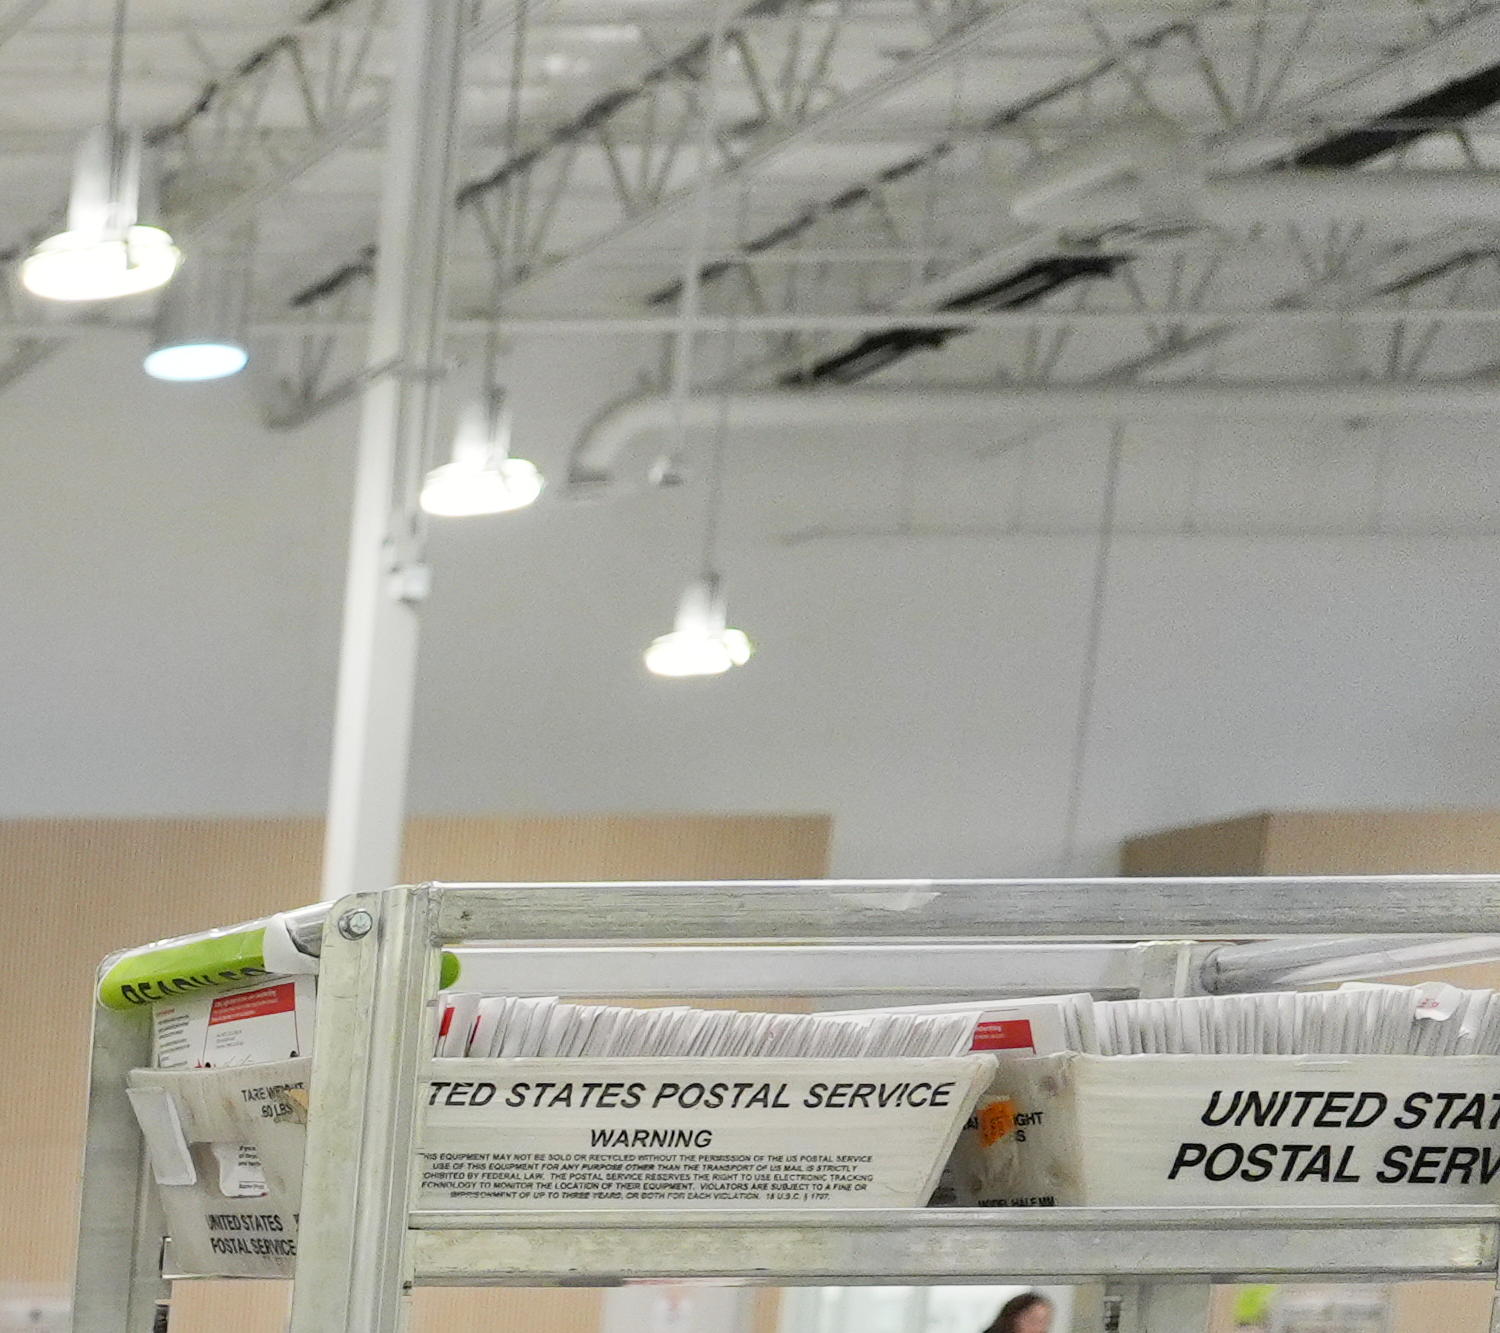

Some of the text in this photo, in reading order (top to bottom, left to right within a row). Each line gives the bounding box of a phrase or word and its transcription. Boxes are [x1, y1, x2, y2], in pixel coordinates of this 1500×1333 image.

[505, 1081, 956, 1109] STATES POSTAL SERVICE
[1200, 1090, 1500, 1130] UNITED STAT
[591, 1129, 713, 1149] WARNING
[1167, 1142, 1361, 1183] POSTAL
